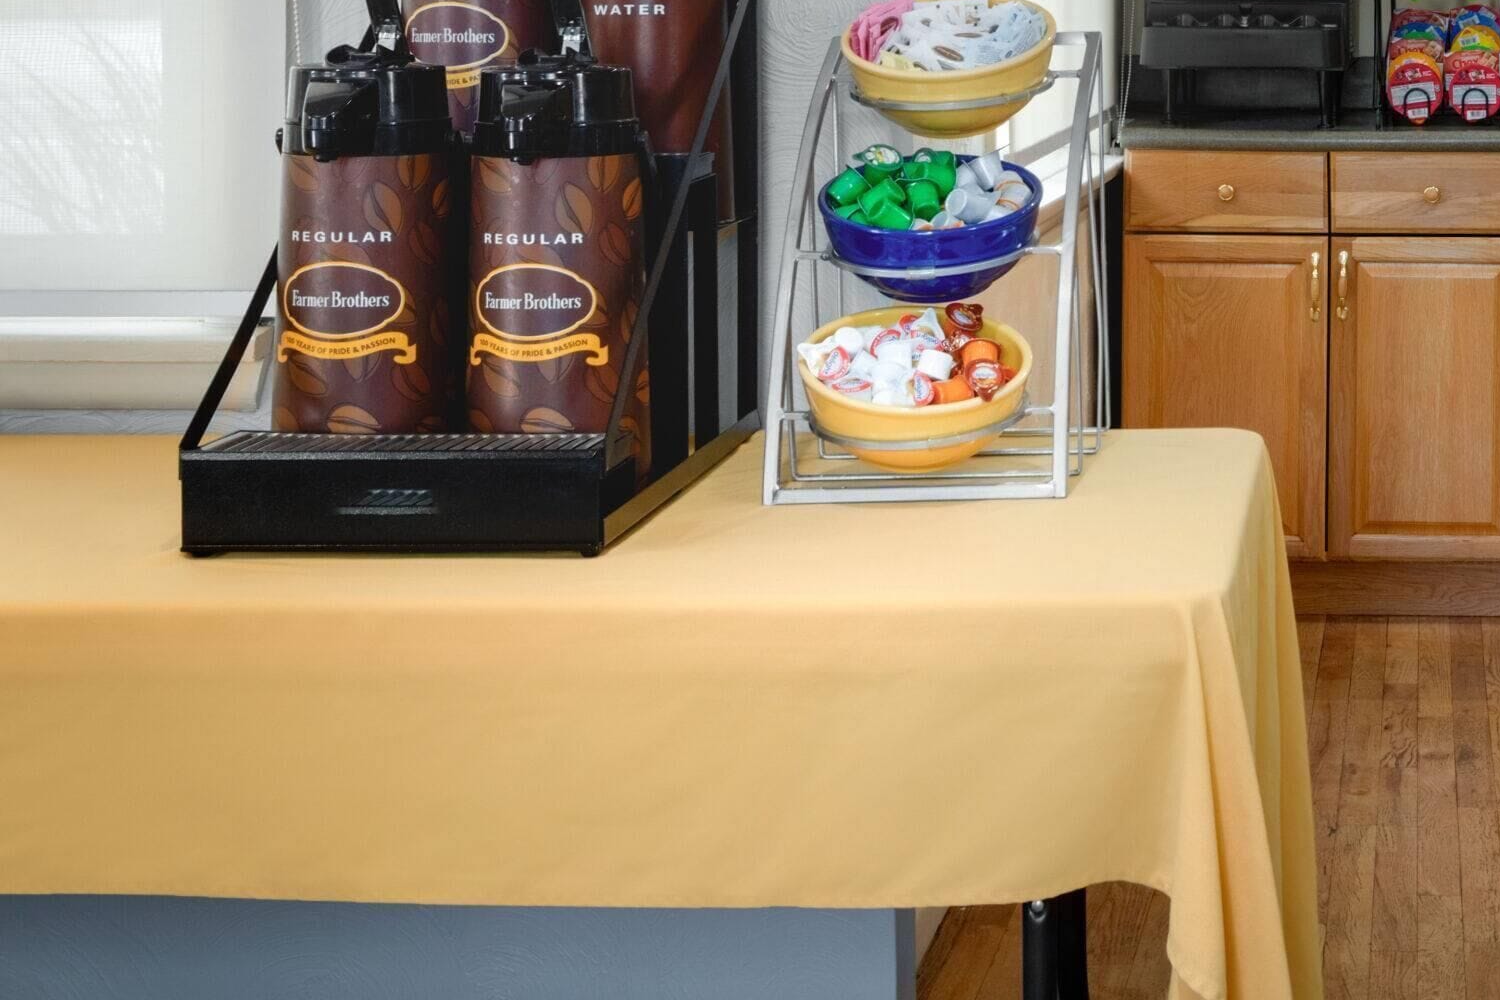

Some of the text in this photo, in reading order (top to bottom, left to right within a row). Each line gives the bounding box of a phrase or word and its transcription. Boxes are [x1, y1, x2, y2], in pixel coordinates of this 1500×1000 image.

[593, 4, 666, 16] WATER
[411, 27, 495, 44] Farmer Brothers
[291, 230, 392, 243] REGULAR
[484, 233, 584, 245] REGULAR
[292, 289, 390, 308] Farmer Brothers
[485, 291, 581, 310] Farmer Brothers
[295, 339, 316, 352] YEARS
[361, 337, 396, 351] PASSION
[489, 342, 508, 354] YEARS
[554, 339, 588, 353] PASSION
